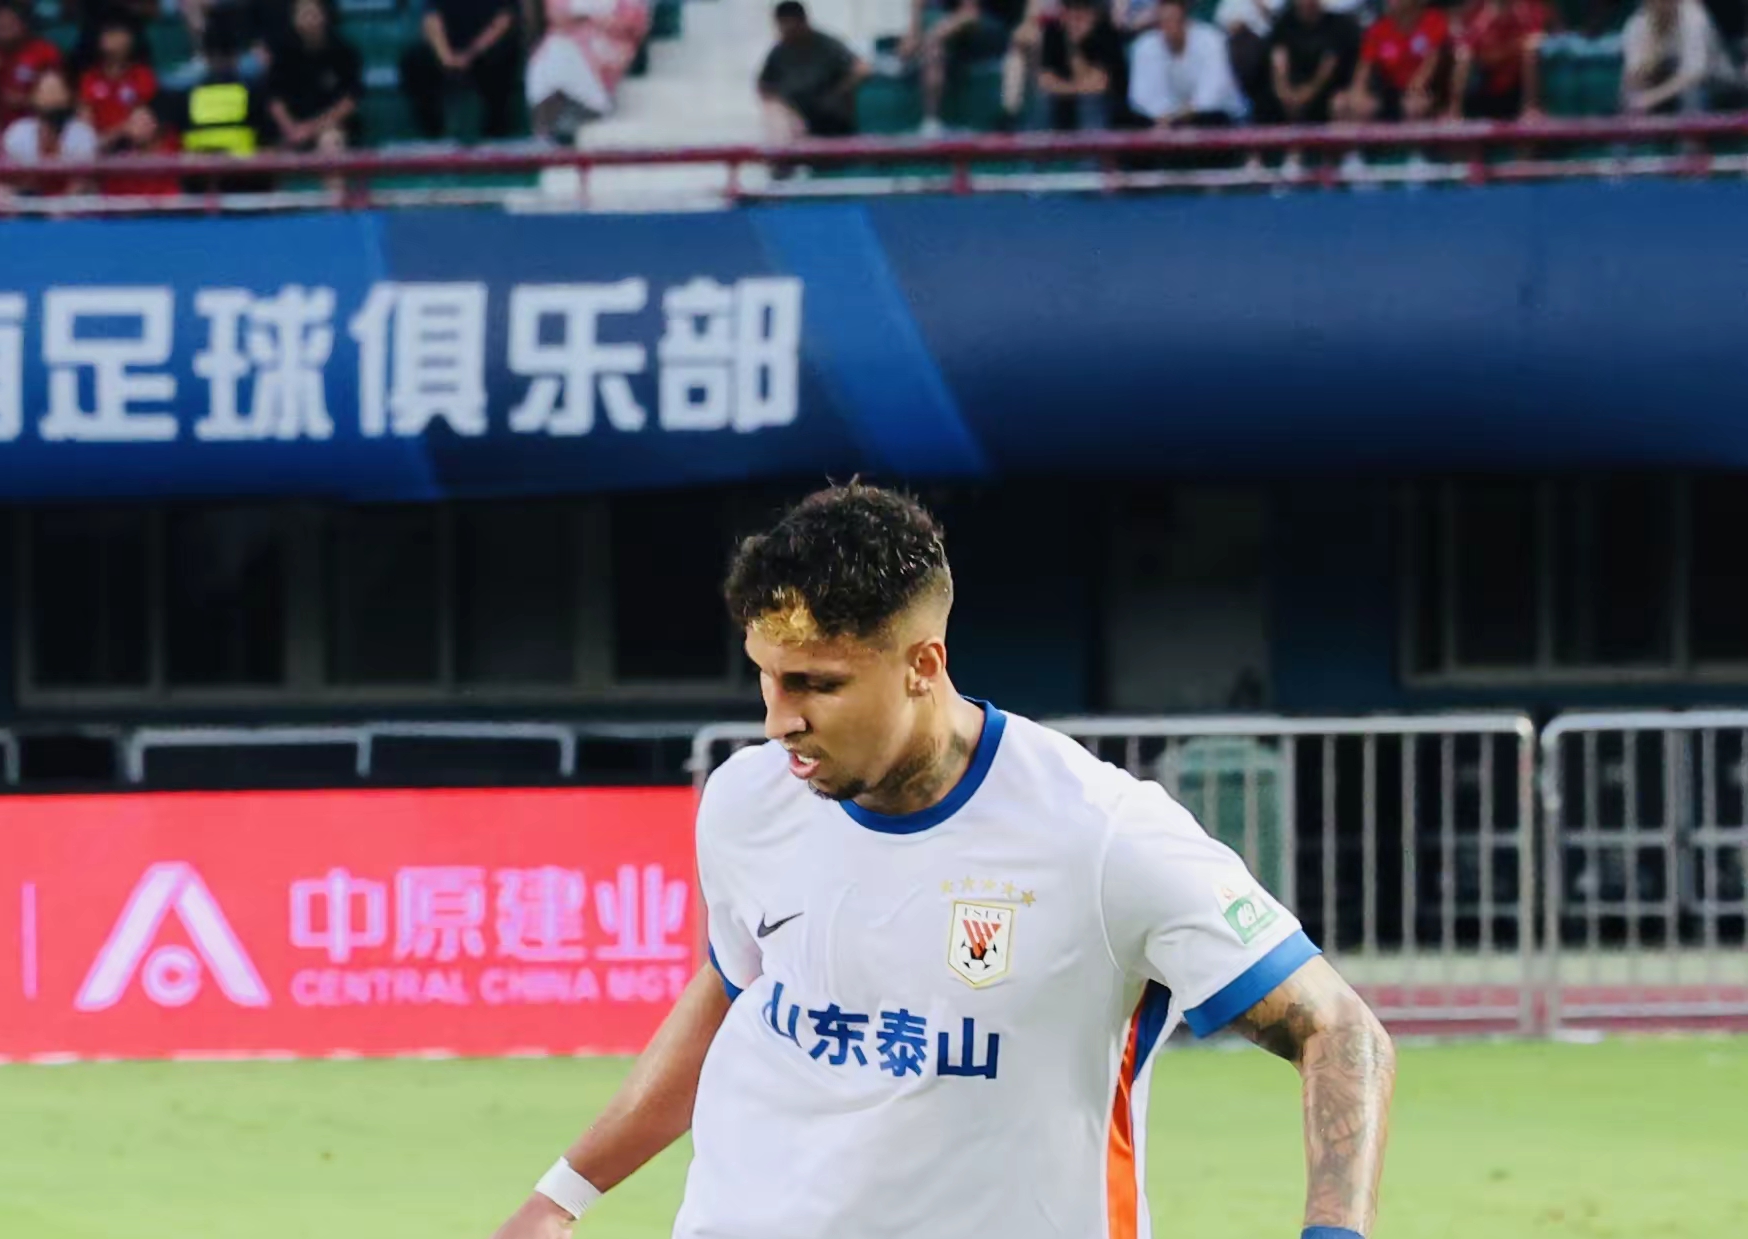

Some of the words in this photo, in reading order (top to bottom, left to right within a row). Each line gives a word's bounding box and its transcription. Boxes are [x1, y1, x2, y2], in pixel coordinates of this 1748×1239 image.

[289, 864, 690, 964] 中原建业
[290, 967, 472, 1006] CENTRAL
[479, 966, 600, 1003] CHINA
[761, 981, 1000, 1080] 山东泰山
